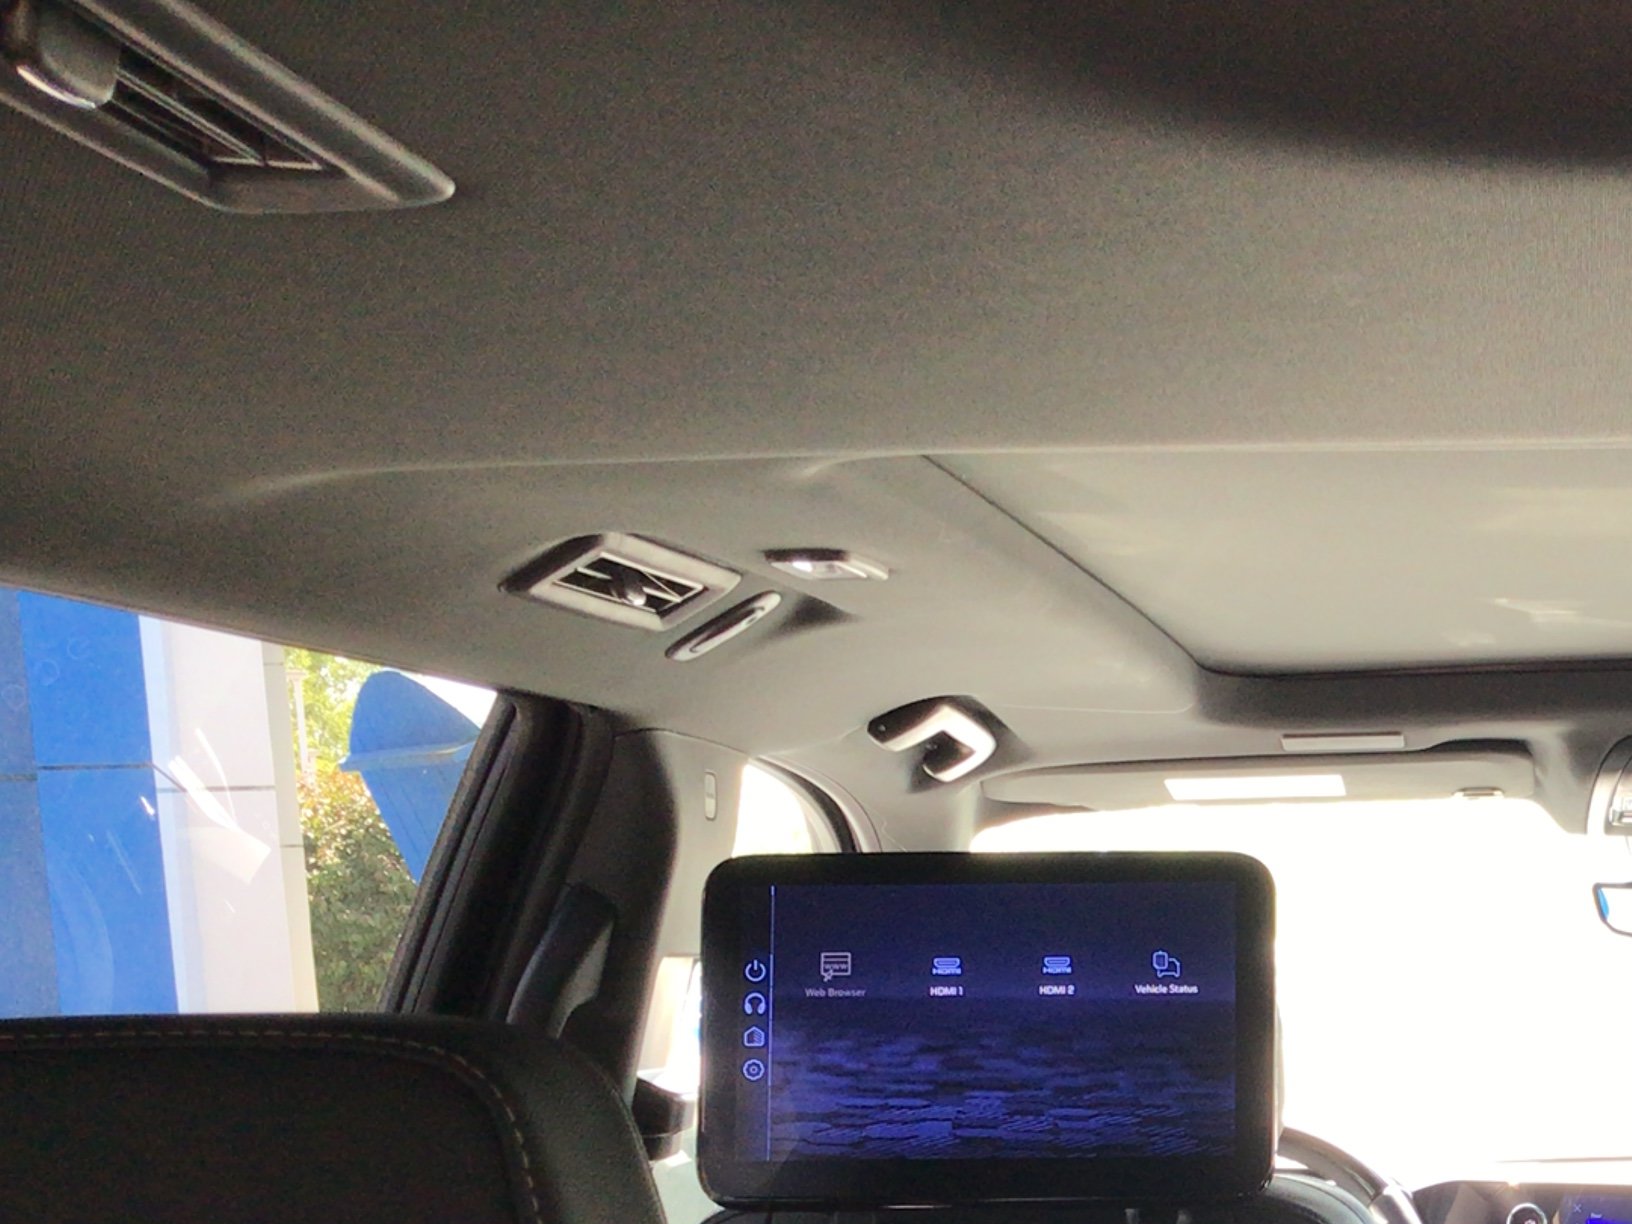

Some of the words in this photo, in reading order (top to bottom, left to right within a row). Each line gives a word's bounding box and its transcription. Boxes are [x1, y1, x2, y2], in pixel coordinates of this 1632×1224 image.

[805, 988, 826, 997] Web
[827, 987, 866, 997] Browser
[930, 986, 958, 996] HDMI
[1039, 985, 1066, 995] HDMI
[1067, 985, 1075, 995] 2
[1135, 984, 1168, 994] Vehicle
[1169, 984, 1198, 994] Status
